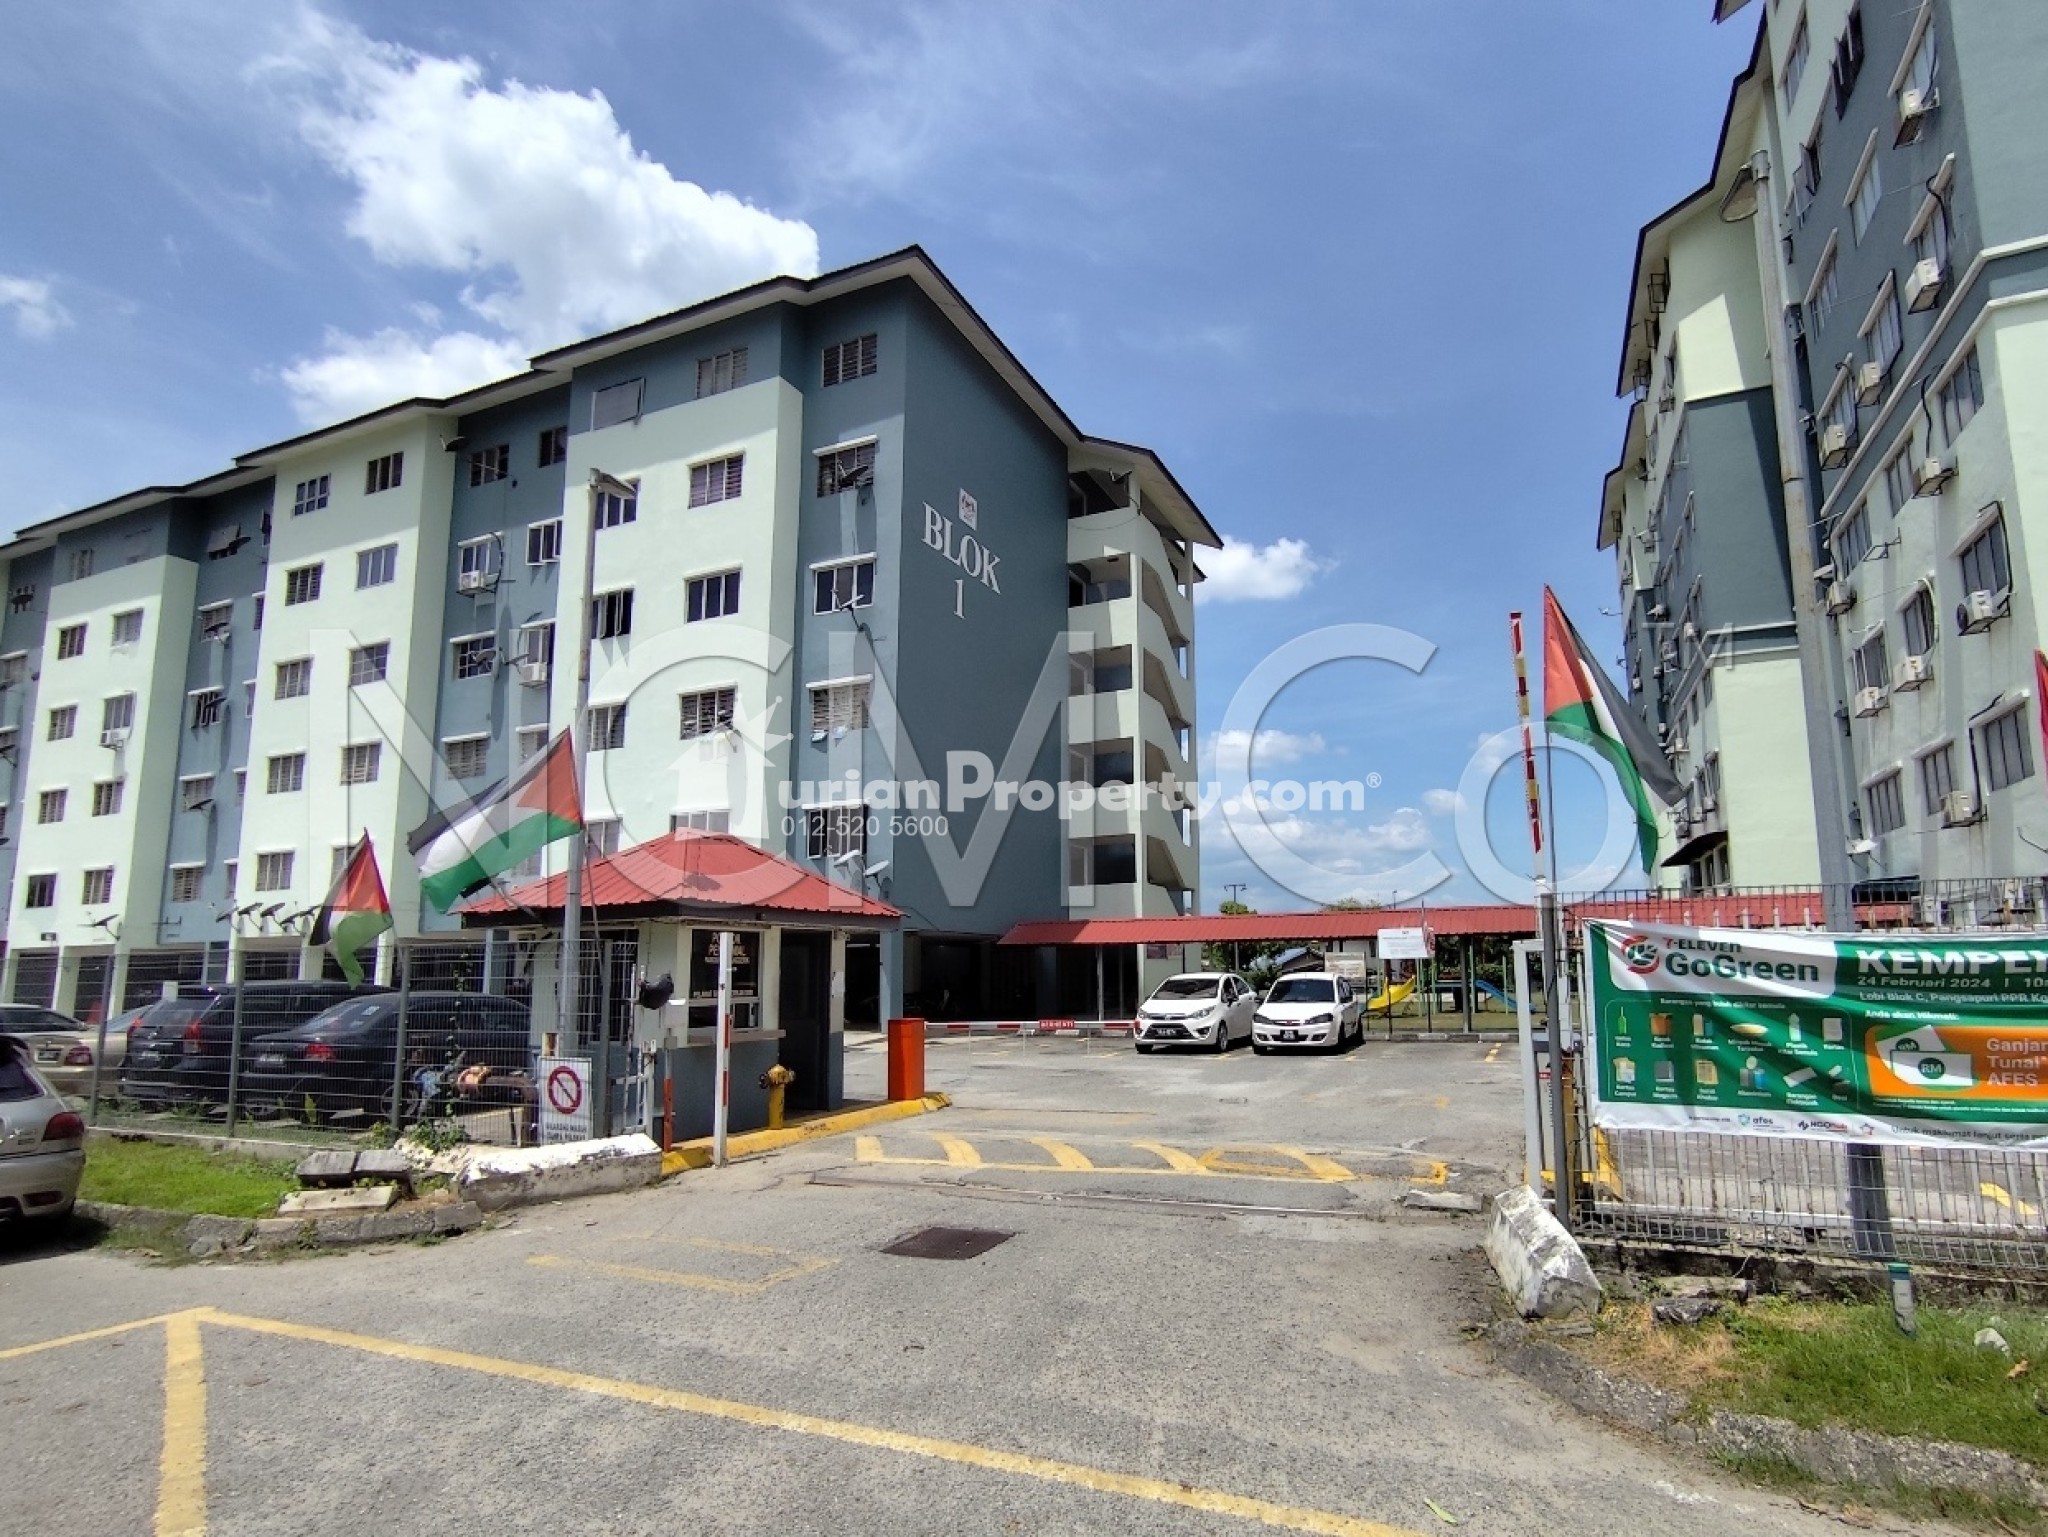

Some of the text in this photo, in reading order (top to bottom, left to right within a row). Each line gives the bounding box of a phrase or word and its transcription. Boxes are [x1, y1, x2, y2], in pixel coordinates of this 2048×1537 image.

[921, 500, 1001, 595] BLOK
[1665, 951, 1820, 983] GoGreen
[1857, 976, 1876, 987] 24
[1881, 976, 1945, 988] Februari
[1949, 977, 1992, 988] 2024
[1986, 1071, 2039, 1088] AFES
